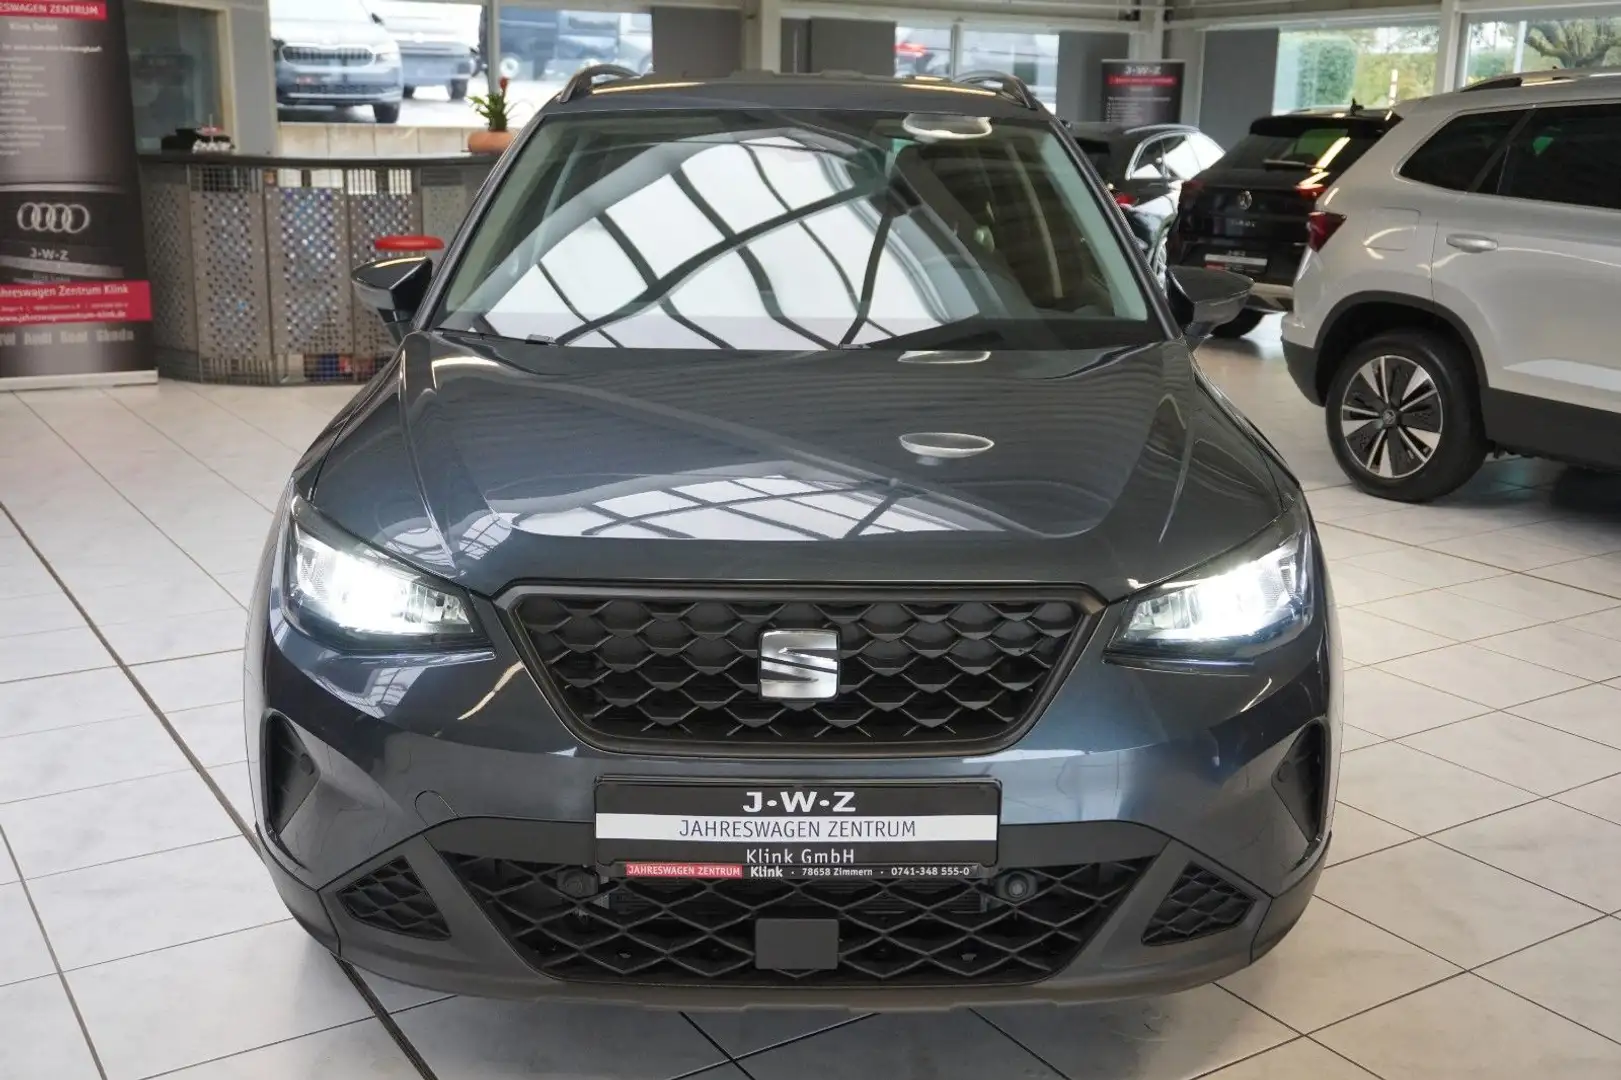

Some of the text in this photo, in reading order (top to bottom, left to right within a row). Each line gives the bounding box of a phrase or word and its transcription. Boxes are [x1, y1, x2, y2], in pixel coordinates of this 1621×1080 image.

[50, 4, 99, 15] ZENTRUM
[58, 284, 101, 297] Zentrum
[103, 283, 129, 295] Klink
[679, 819, 916, 839] JAHRESWAGEN ZENTRUM
[746, 848, 854, 864] Klink GmbH
[627, 865, 970, 878] JAHRESWAGEN ZENTRUM Klink 78658 Zimmern 0741-348 555-0
